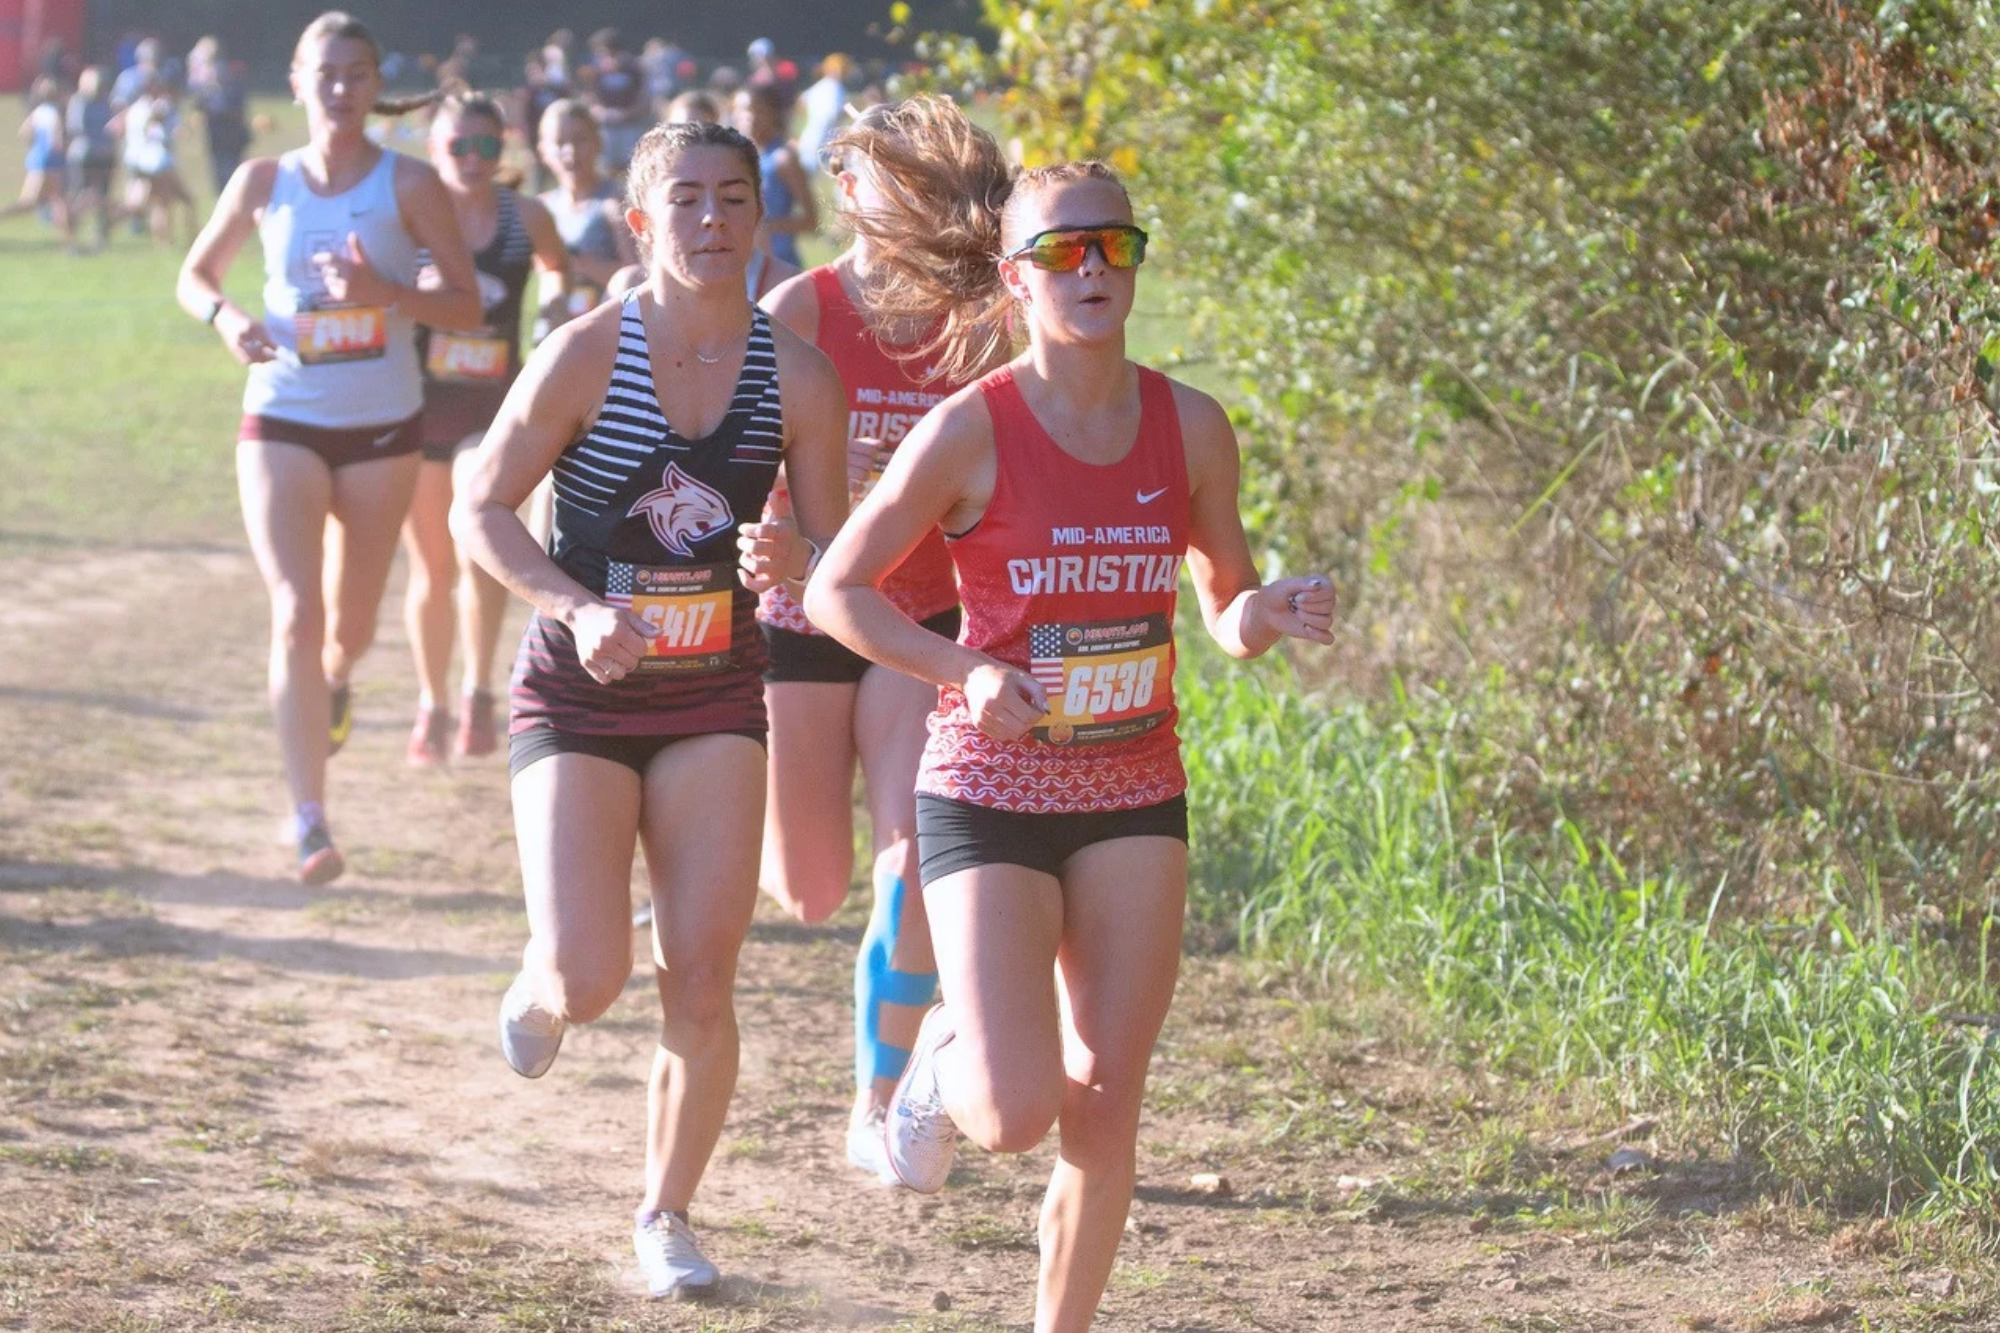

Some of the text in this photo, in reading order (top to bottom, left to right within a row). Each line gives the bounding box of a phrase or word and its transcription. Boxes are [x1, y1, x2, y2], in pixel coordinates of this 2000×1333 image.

[1052, 526, 1171, 546] MID-AMERICA
[640, 601, 716, 648] 6417
[1063, 656, 1158, 717] 6538
